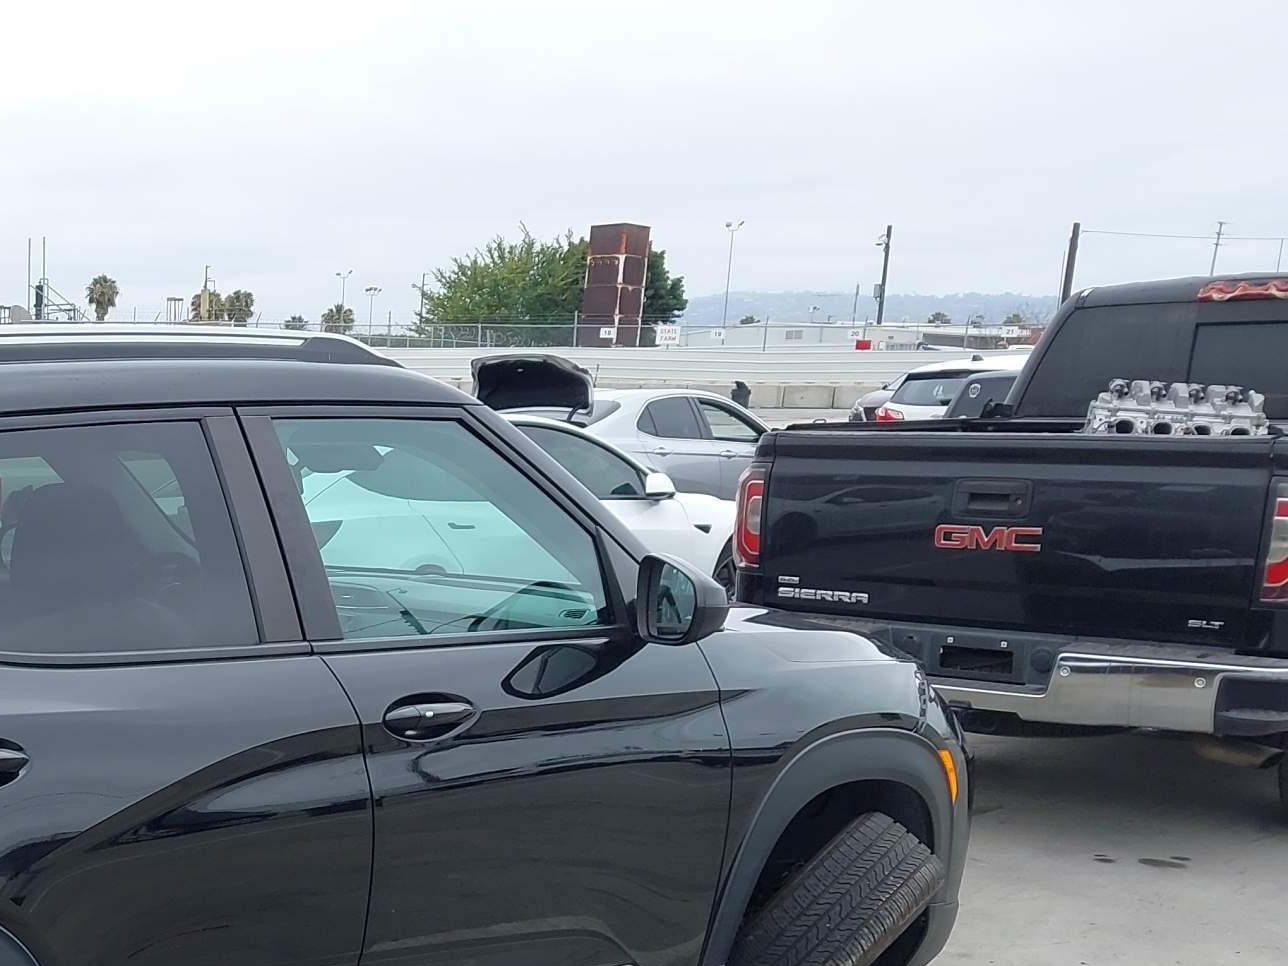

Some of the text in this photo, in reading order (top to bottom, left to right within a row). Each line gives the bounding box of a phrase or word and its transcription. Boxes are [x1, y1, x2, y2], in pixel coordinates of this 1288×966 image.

[934, 524, 1043, 552] GMC
[777, 587, 869, 604] SIERRA
[1187, 620, 1225, 629] SLT
